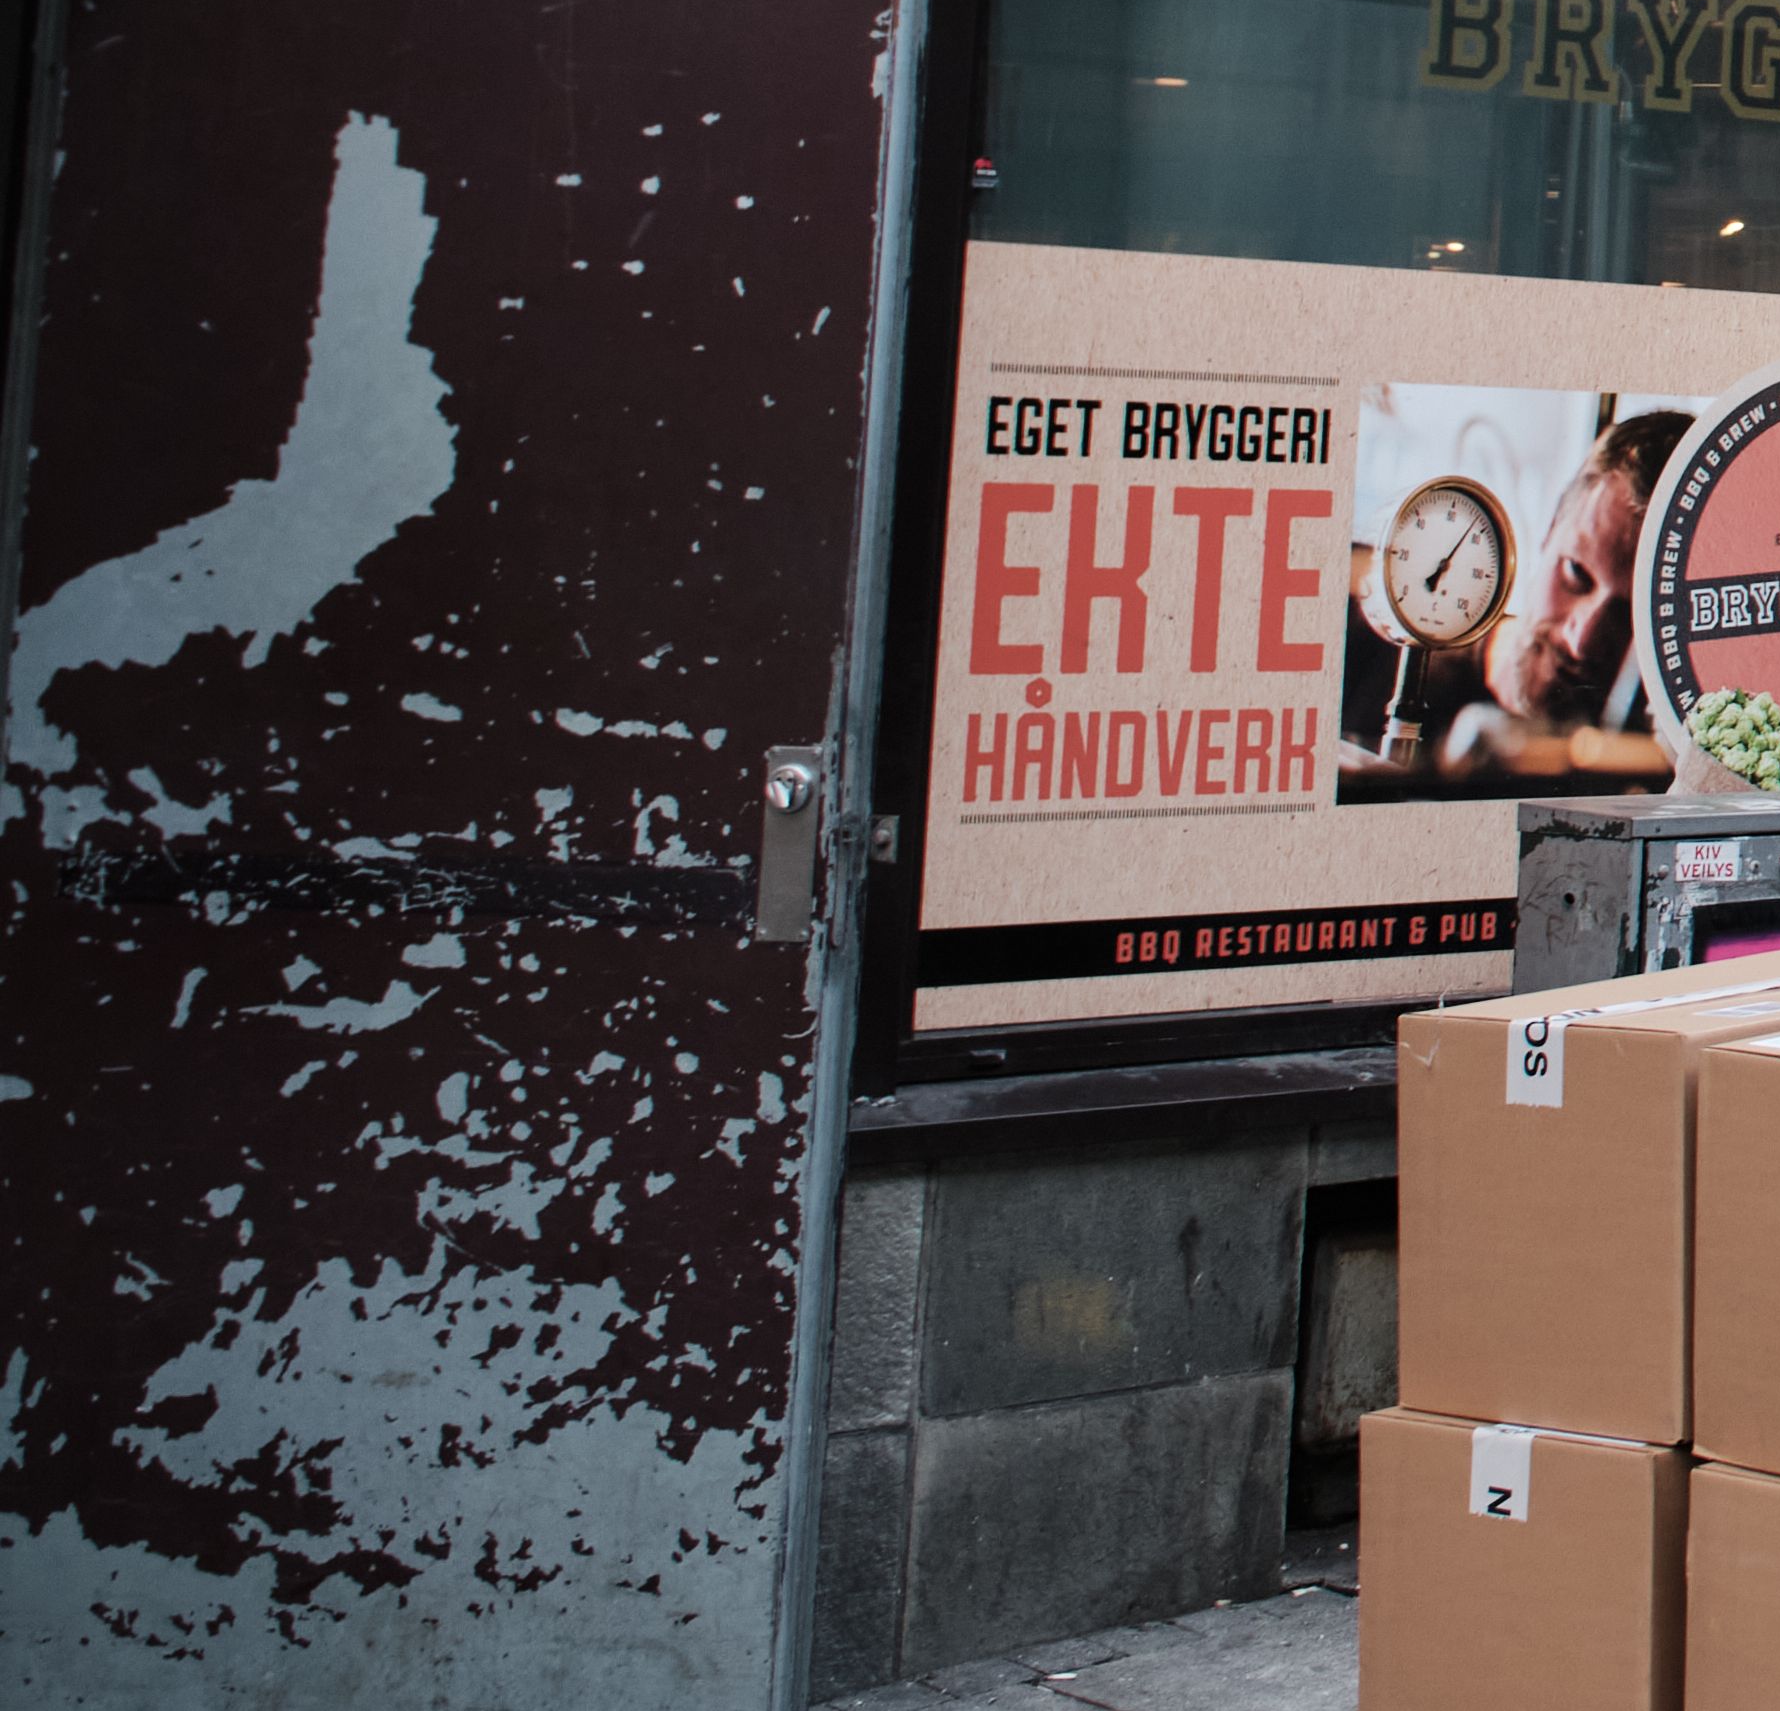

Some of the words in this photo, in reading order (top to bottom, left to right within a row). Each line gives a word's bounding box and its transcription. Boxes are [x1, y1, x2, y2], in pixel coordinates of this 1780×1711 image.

[985, 396, 1102, 457] EGET
[1122, 400, 1333, 464] BRYGGERI
[1681, 472, 1709, 512] BBQ
[1717, 406, 1766, 451] BREW
[968, 482, 1334, 675] EKTE
[1660, 531, 1681, 595] BREW
[1663, 617, 1682, 671] BBQ
[961, 676, 1318, 802] HÅNDVERK
[1681, 863, 1734, 878] VEILYS
[1695, 845, 1721, 860] KIV
[1115, 929, 1180, 964] BBQ
[1195, 919, 1397, 958] RESTAURANT
[1408, 917, 1428, 945] &
[1440, 911, 1498, 942] PUB
